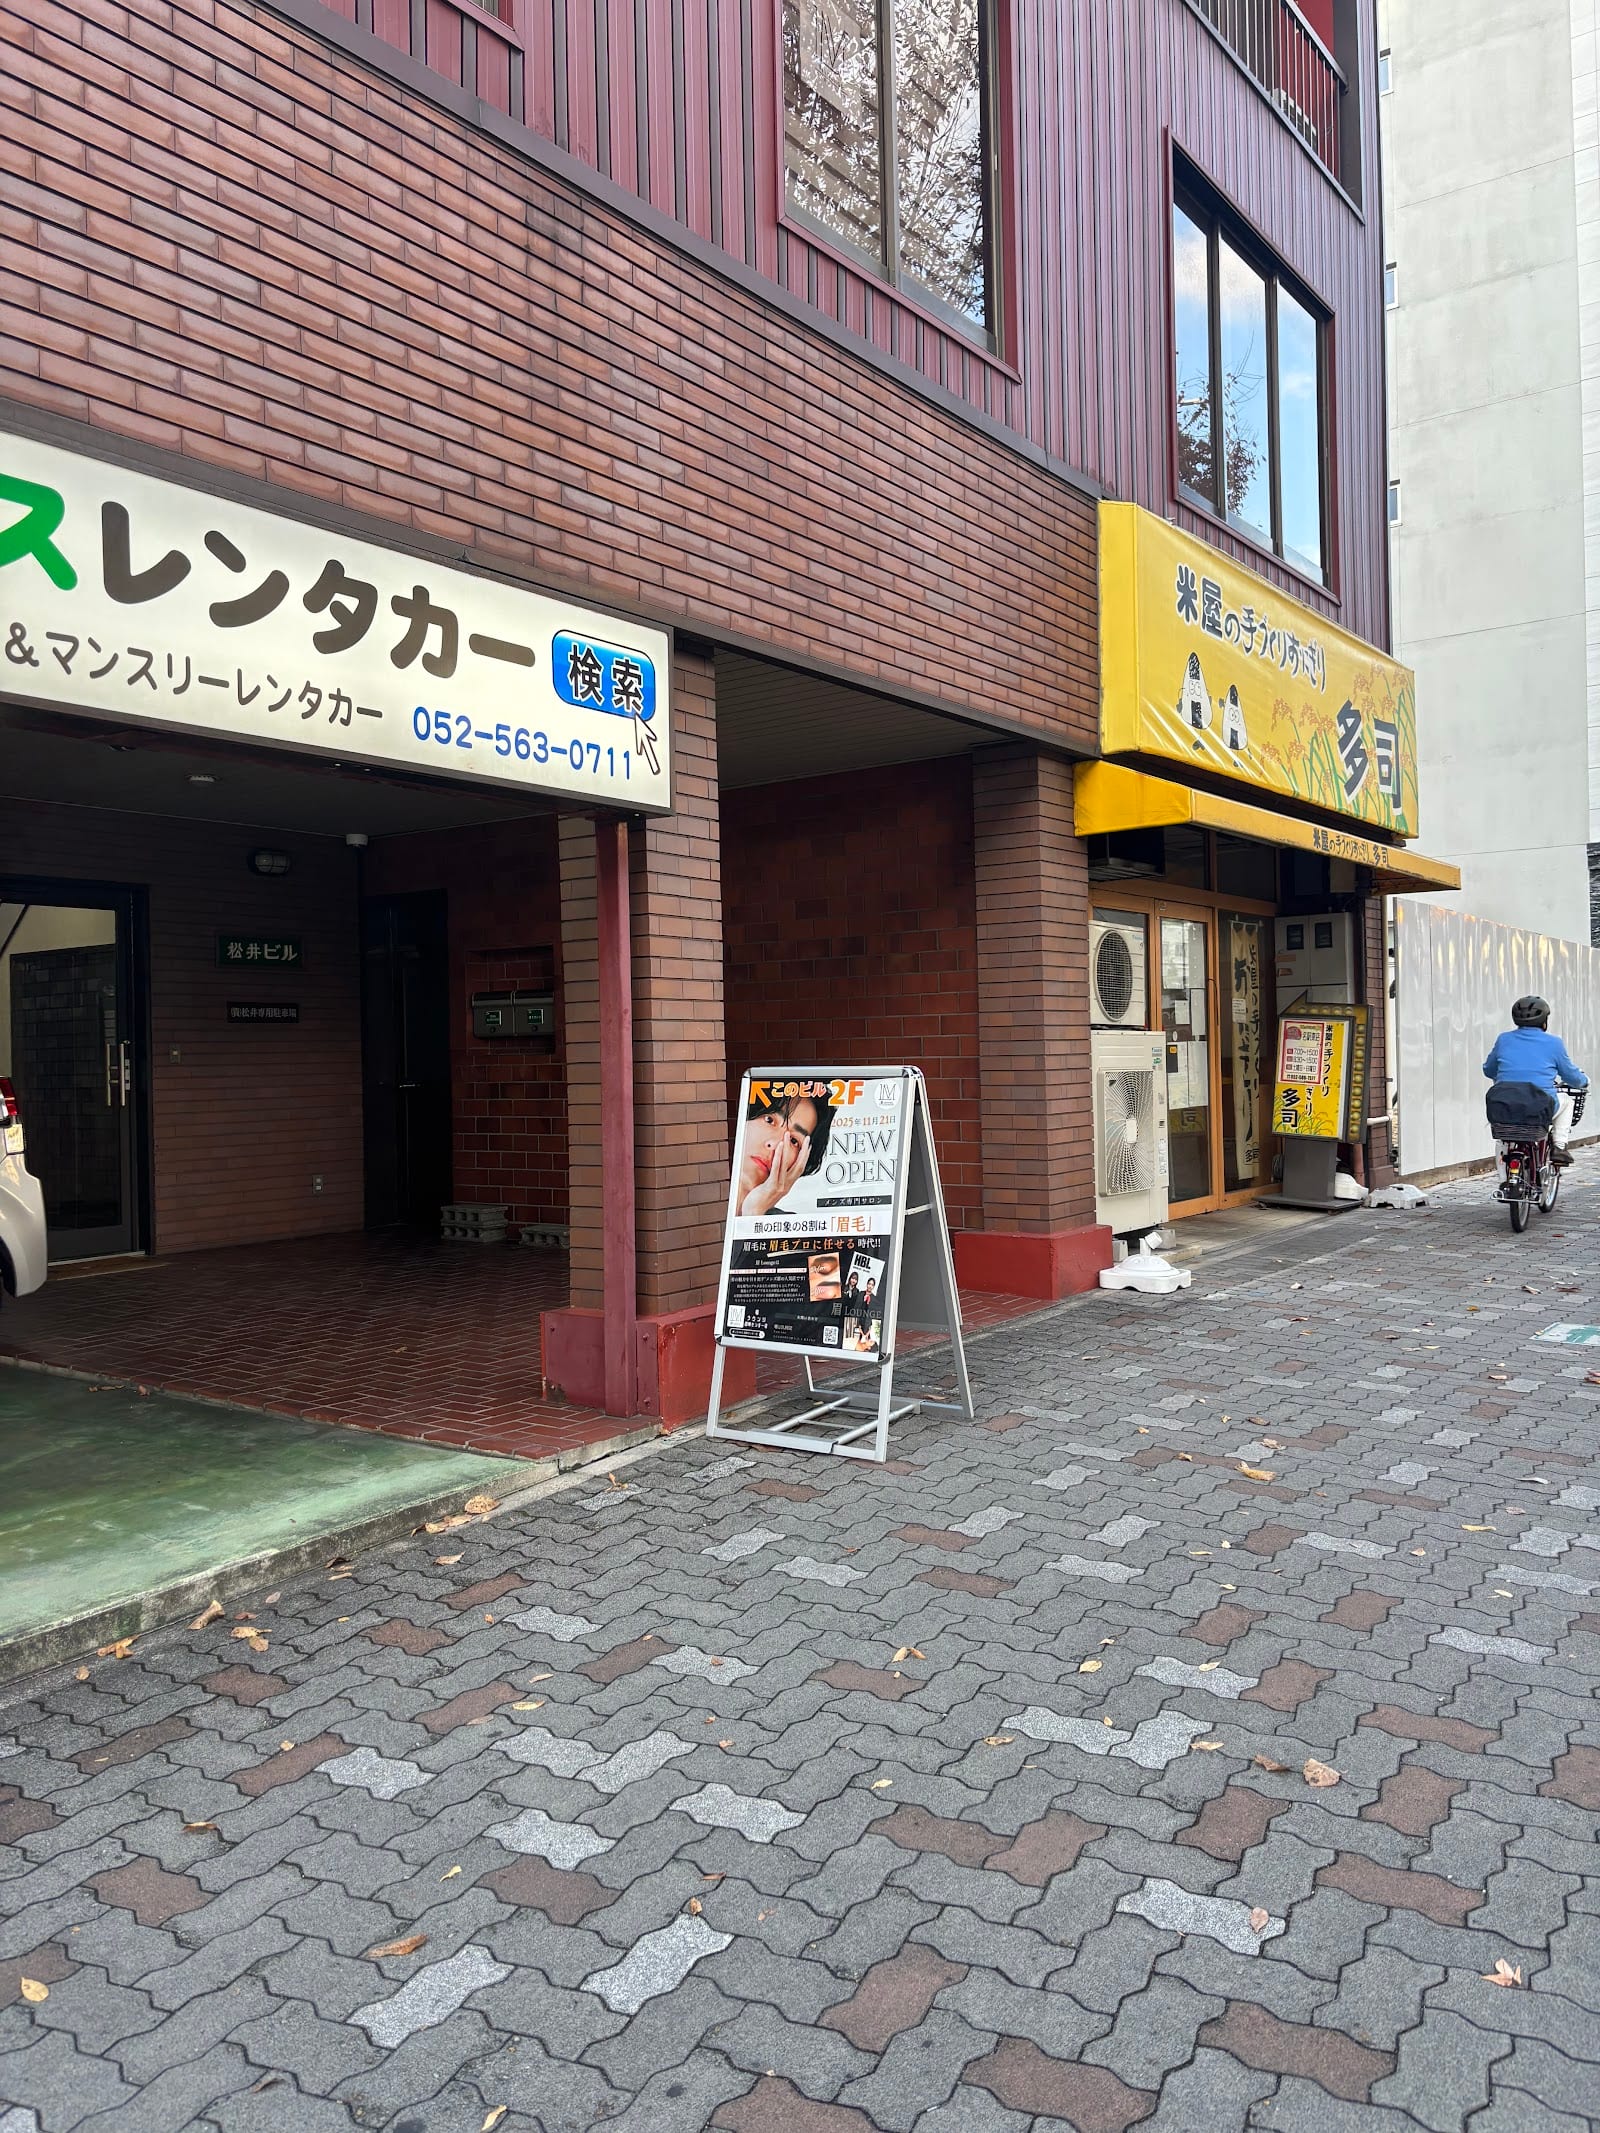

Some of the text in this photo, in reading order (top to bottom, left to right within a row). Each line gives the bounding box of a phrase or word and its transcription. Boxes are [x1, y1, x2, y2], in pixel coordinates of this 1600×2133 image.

[1175, 563, 1327, 692] 米屋の手づくりおにぎり
[566, 642, 646, 713] 検索
[412, 706, 632, 780] 052-563-0711
[1336, 699, 1402, 815] 多司
[1372, 844, 1390, 868] 多司
[226, 942, 298, 961] 松井ビル
[771, 1079, 864, 1106] このビル 2F
[831, 1115, 896, 1127] 2025年11月21日
[1281, 1088, 1300, 1128] 多司
[829, 1129, 896, 1156] NEW
[825, 1159, 897, 1185] OPEN
[824, 1197, 883, 1206] メンズ専門サロン
[854, 1254, 872, 1270] HBL
[831, 1303, 882, 1318] 眉 LOUNGE
